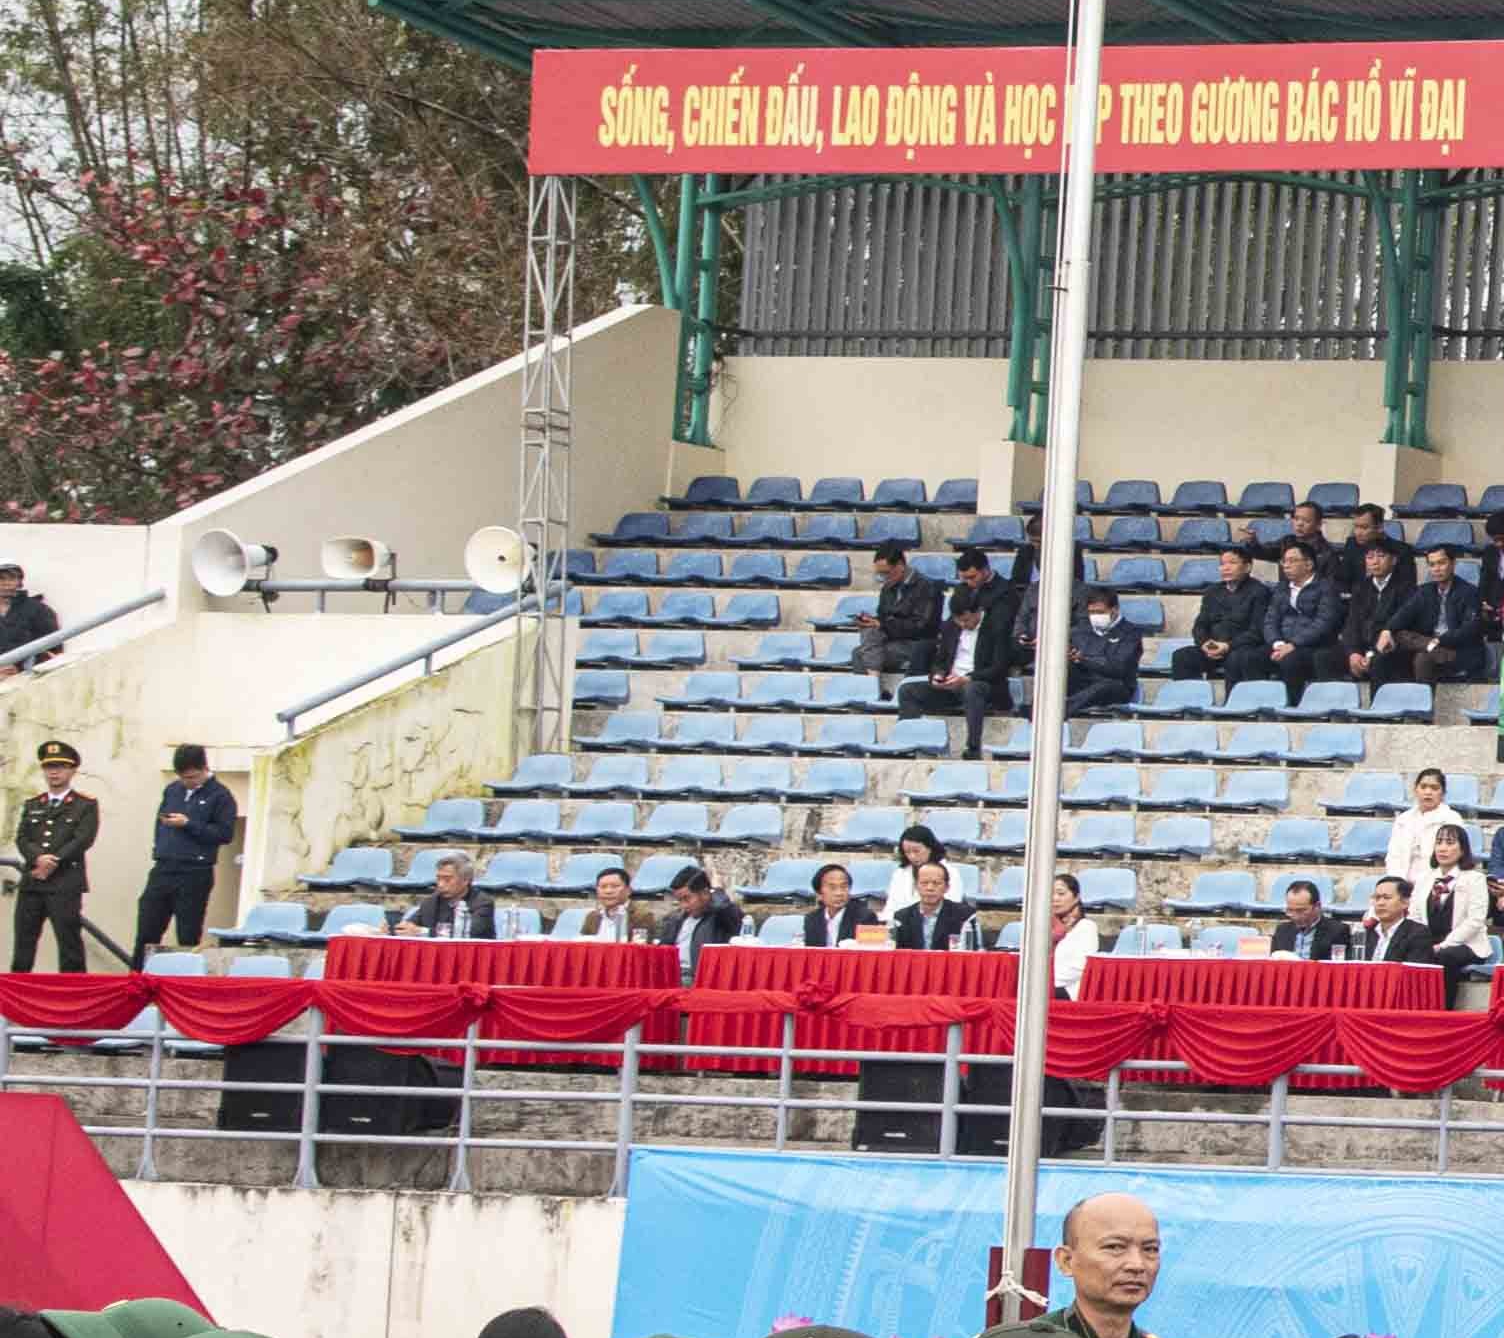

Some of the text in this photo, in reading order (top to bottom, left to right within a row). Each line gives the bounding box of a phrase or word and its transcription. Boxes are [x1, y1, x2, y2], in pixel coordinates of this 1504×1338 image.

[599, 64, 675, 154] SỐNG,
[682, 66, 760, 147] CHIẾN
[765, 63, 823, 154] ĐẤU,
[831, 85, 880, 147] LAO
[885, 71, 958, 160] ĐỘNG
[965, 71, 997, 146] VÀ
[1003, 83, 1057, 159] HỌC
[1119, 83, 1183, 144] THEO
[1189, 75, 1279, 144] GƯƠNG
[1285, 67, 1339, 142] BÁC
[1345, 58, 1383, 142] HỒ
[1388, 66, 1417, 141] VĨ
[1419, 79, 1466, 155] ĐẠI
